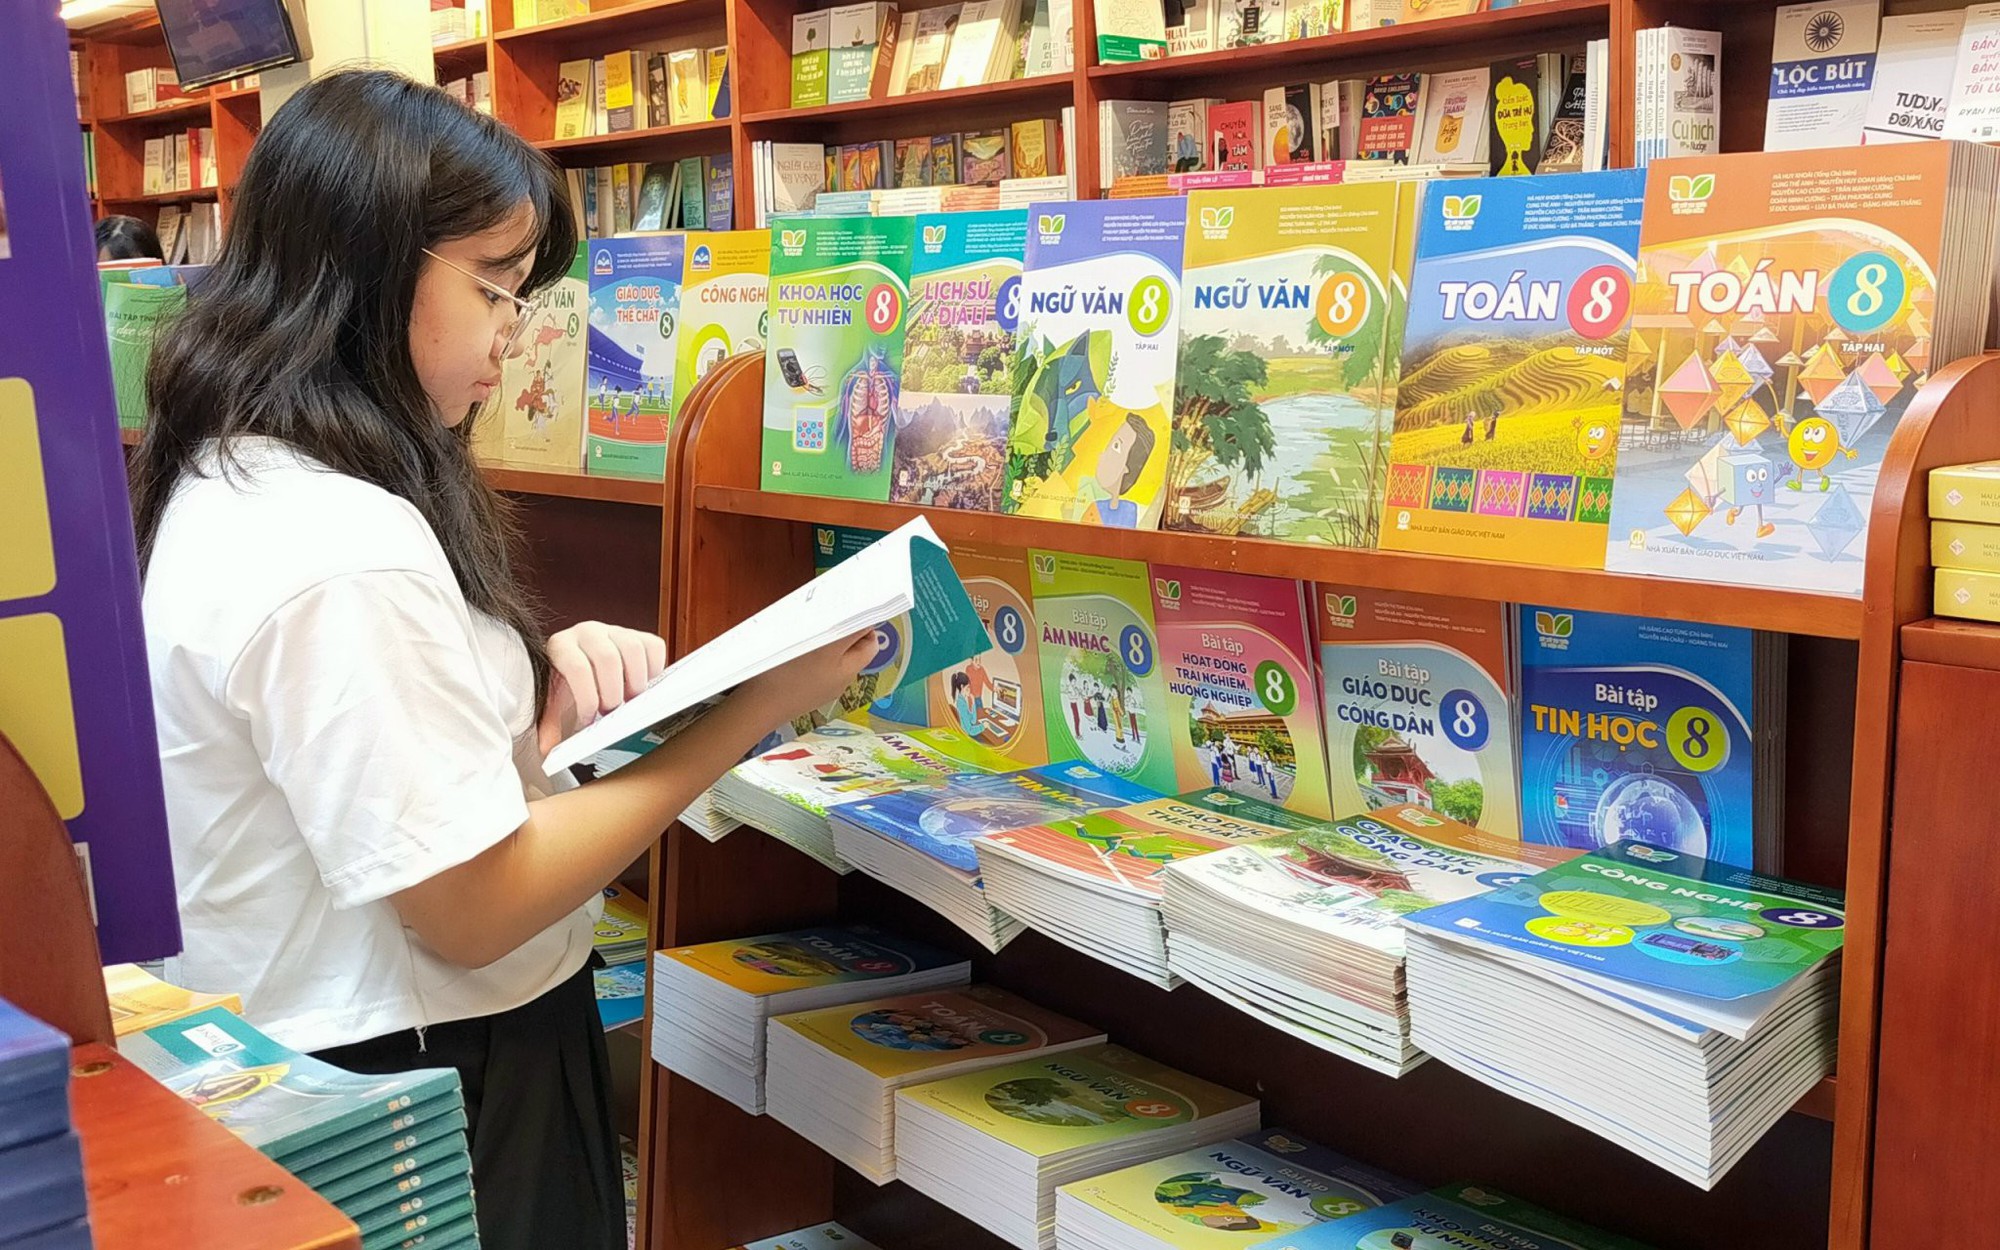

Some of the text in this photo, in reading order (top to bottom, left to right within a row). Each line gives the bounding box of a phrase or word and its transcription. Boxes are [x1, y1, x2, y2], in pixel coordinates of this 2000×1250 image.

[1777, 59, 1867, 88] LỘC BÚT
[1690, 141, 1708, 154] Nudge
[554, 286, 575, 309] VĂN
[616, 283, 660, 303] GIÁO DỤC
[700, 284, 737, 303] CÔNG
[778, 285, 863, 302] KHOA HỌC
[925, 273, 991, 302] LỊCH SỬ
[1194, 277, 1354, 323] NGỮ VĂN 8
[1438, 269, 1617, 323] TOÁN 8
[1668, 258, 1888, 316] TOÁN 8
[616, 305, 660, 322] THỂ CHẤT
[778, 305, 851, 325] TỰ NHIÊN
[873, 290, 892, 325] 8
[920, 303, 987, 326] VÀ ĐỊA LÍ
[1003, 285, 1020, 320] 8
[1030, 283, 1161, 329] NGỮ VĂN 8
[569, 315, 578, 335] 8
[662, 315, 671, 336] 8
[1575, 345, 1613, 356] TẬP MỘT
[1842, 342, 1884, 353] TẬP HAI
[1661, 546, 1679, 554] XUẤT
[1680, 548, 1694, 556] BẢN
[1696, 549, 1713, 557] GIÁO
[1714, 550, 1730, 559] DỤC
[973, 594, 989, 611] tập
[1003, 612, 1017, 644] 8
[1073, 608, 1107, 630] Bài tập
[1042, 621, 1110, 655] ÂM NHẠC
[1129, 631, 1143, 666] 8
[1201, 632, 1245, 656] Bài tập
[1182, 652, 1247, 674] HOẠT ĐỘNG
[1378, 658, 1430, 683] Bài tập
[1175, 665, 1250, 692] TRẢI NGHIỆM,
[1265, 668, 1286, 705] 8
[1169, 682, 1252, 709] HƯỚNG NGHIỆP
[1342, 677, 1432, 708] GIÁO DỤC
[1595, 682, 1658, 711] Bài tập
[1337, 701, 1434, 737] CÔNG DÂN
[1453, 699, 1477, 738] 8
[1530, 703, 1659, 752] TIN HỌC
[879, 732, 911, 752] ÂM
[1682, 715, 1711, 760] 8
[1007, 774, 1050, 797] TIN
[1355, 819, 1423, 851] GIÁO
[1335, 823, 1474, 876] CÔNG DÂN
[1579, 862, 1669, 891] CÔNG
[1670, 886, 1766, 912] NGHỆ
[1777, 911, 1828, 927] 8
[801, 934, 862, 962] TOÁN
[862, 960, 892, 972] 8
[921, 1000, 988, 1032] TOÁN
[1045, 1063, 1130, 1101] NGỮ VĂN
[1135, 1102, 1171, 1116] 8
[1208, 1151, 1312, 1199] NGỮ VĂN
[1279, 1167, 1329, 1194] Bài tập
[1323, 1201, 1362, 1216] 8
[1409, 1219, 1439, 1236] TỰ
[1413, 1208, 1473, 1237] KHOA
[1479, 1223, 1508, 1239] Bài
